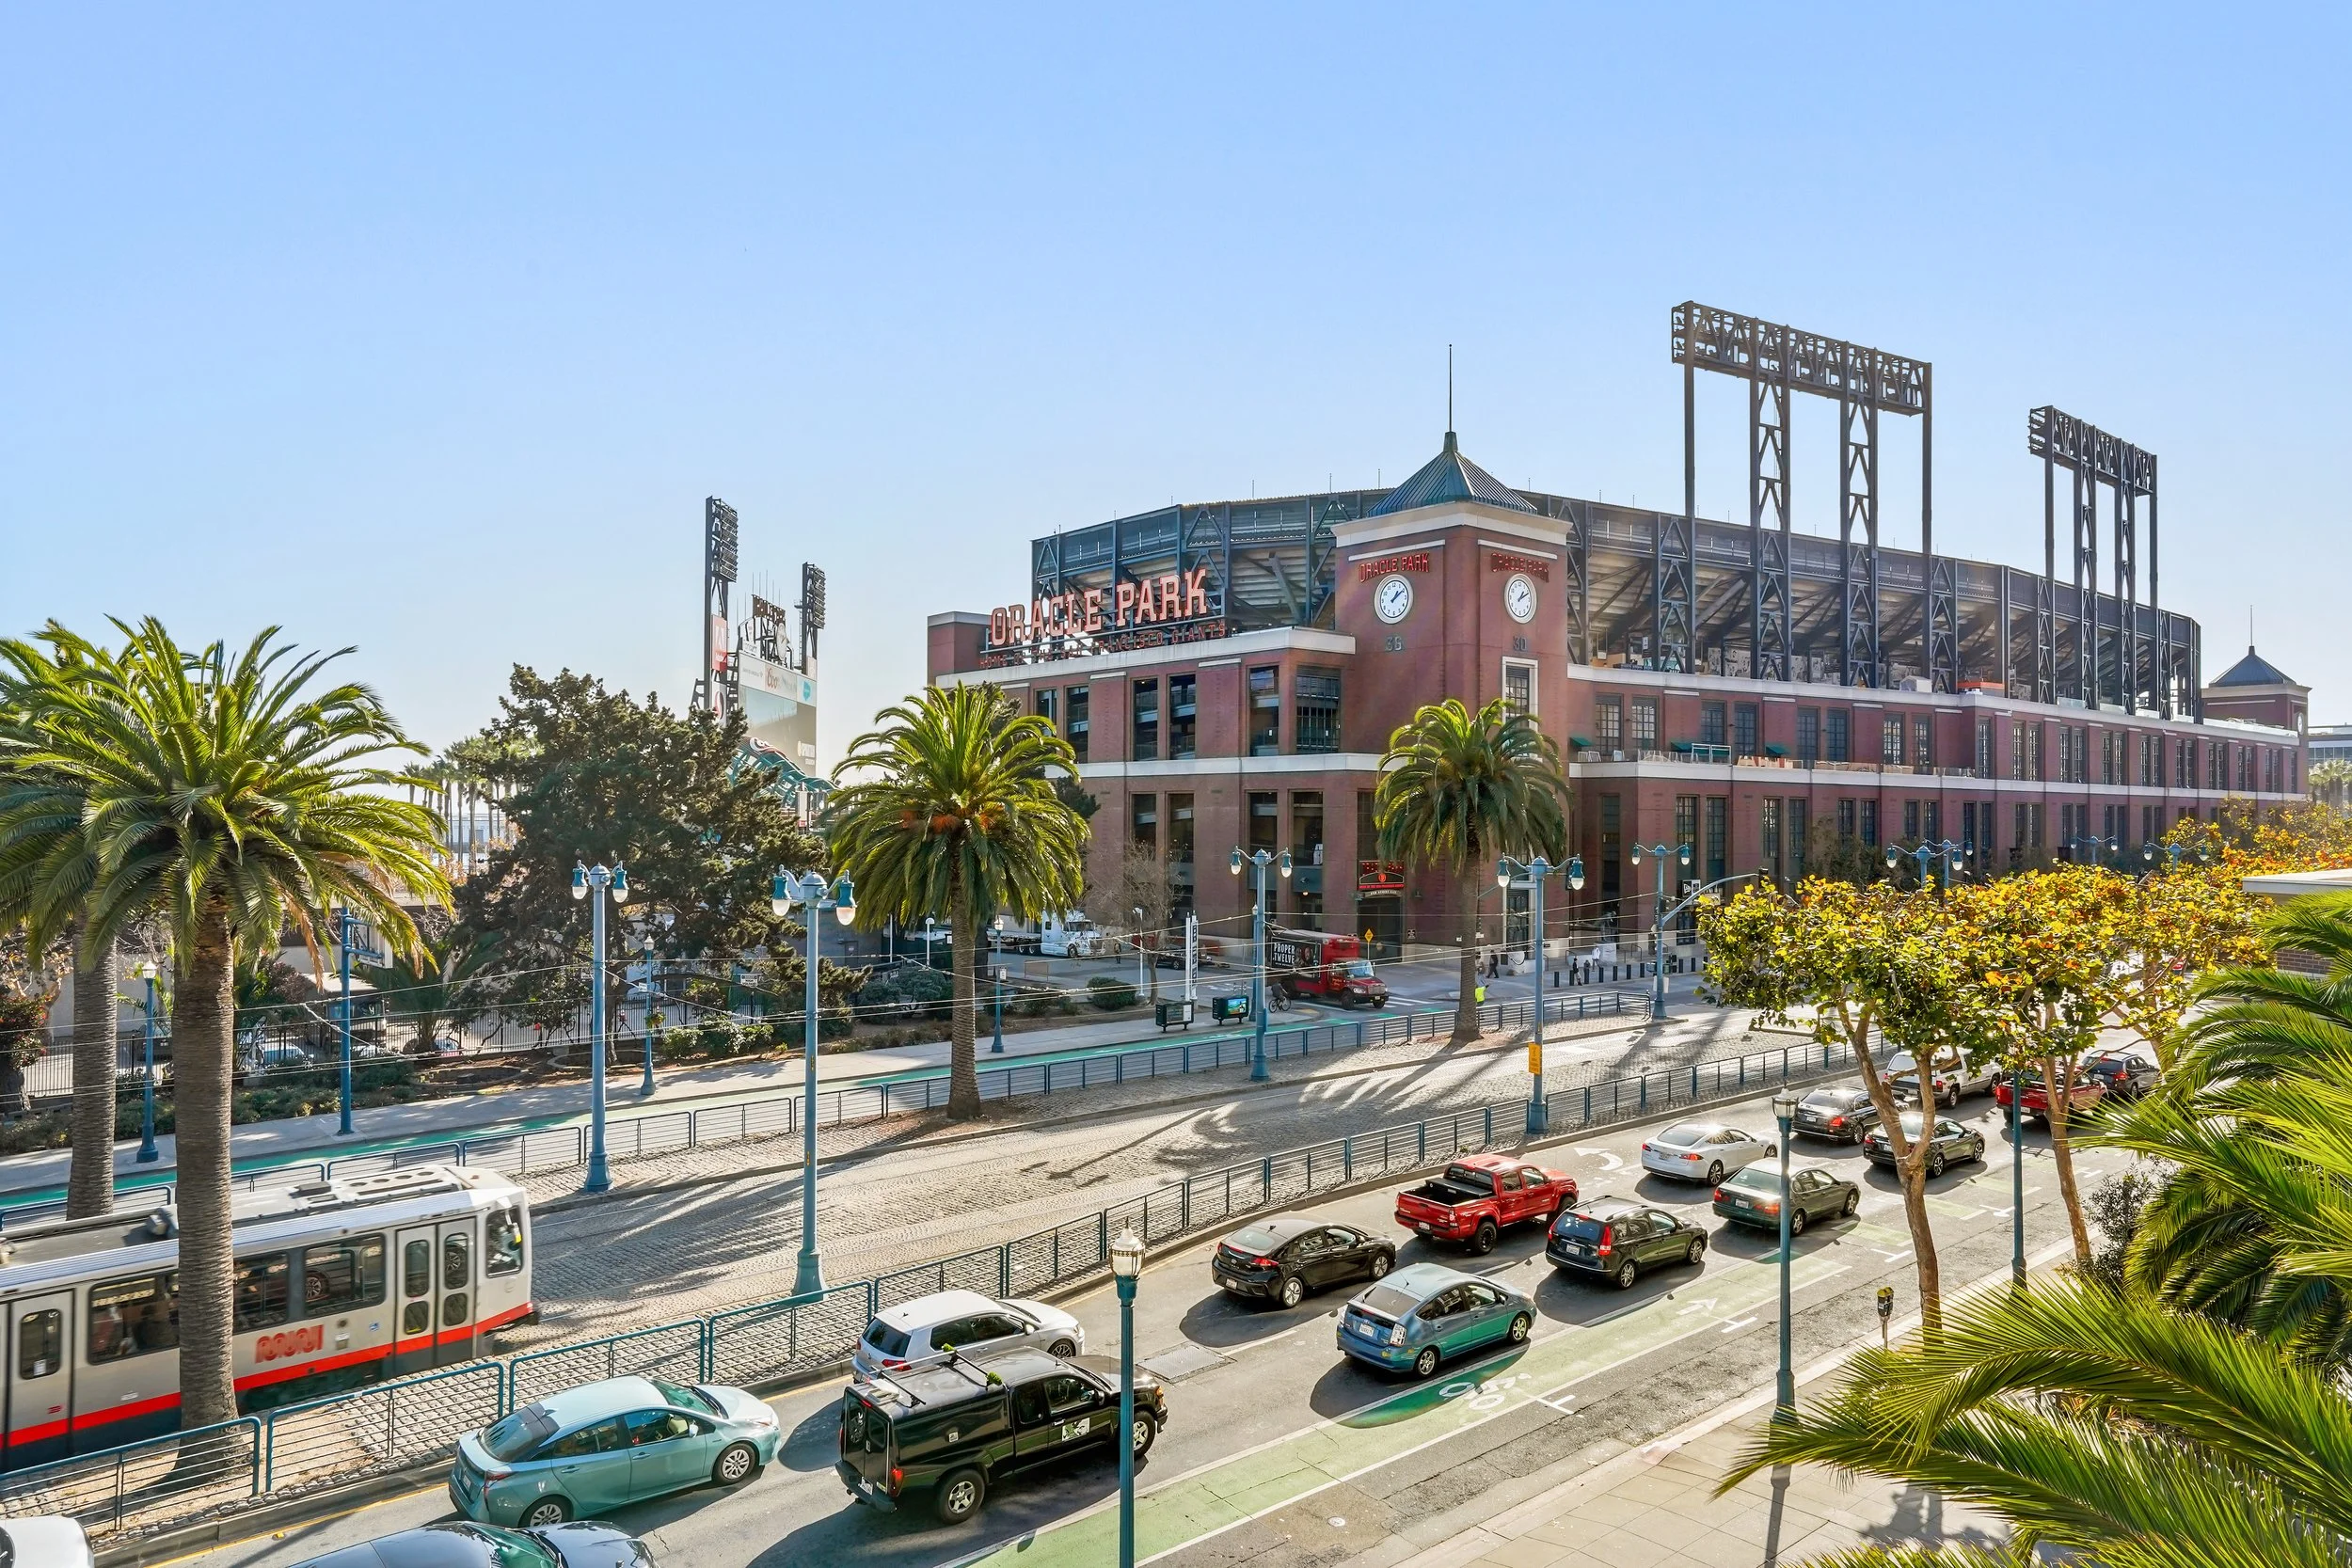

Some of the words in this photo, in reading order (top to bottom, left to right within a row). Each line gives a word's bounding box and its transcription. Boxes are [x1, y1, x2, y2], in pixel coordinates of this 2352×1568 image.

[1359, 558, 1399, 582] ORACLE
[1401, 552, 1429, 573] PARK
[1490, 552, 1526, 573] ORACLE
[991, 589, 1102, 646] ORACLE
[1116, 568, 1207, 627] PARK
[1091, 631, 1163, 656] FRANCISCO
[1171, 621, 1226, 644] GIANTS
[1274, 942, 1295, 955] PROPER
[1274, 952, 1295, 964] TWELVE
